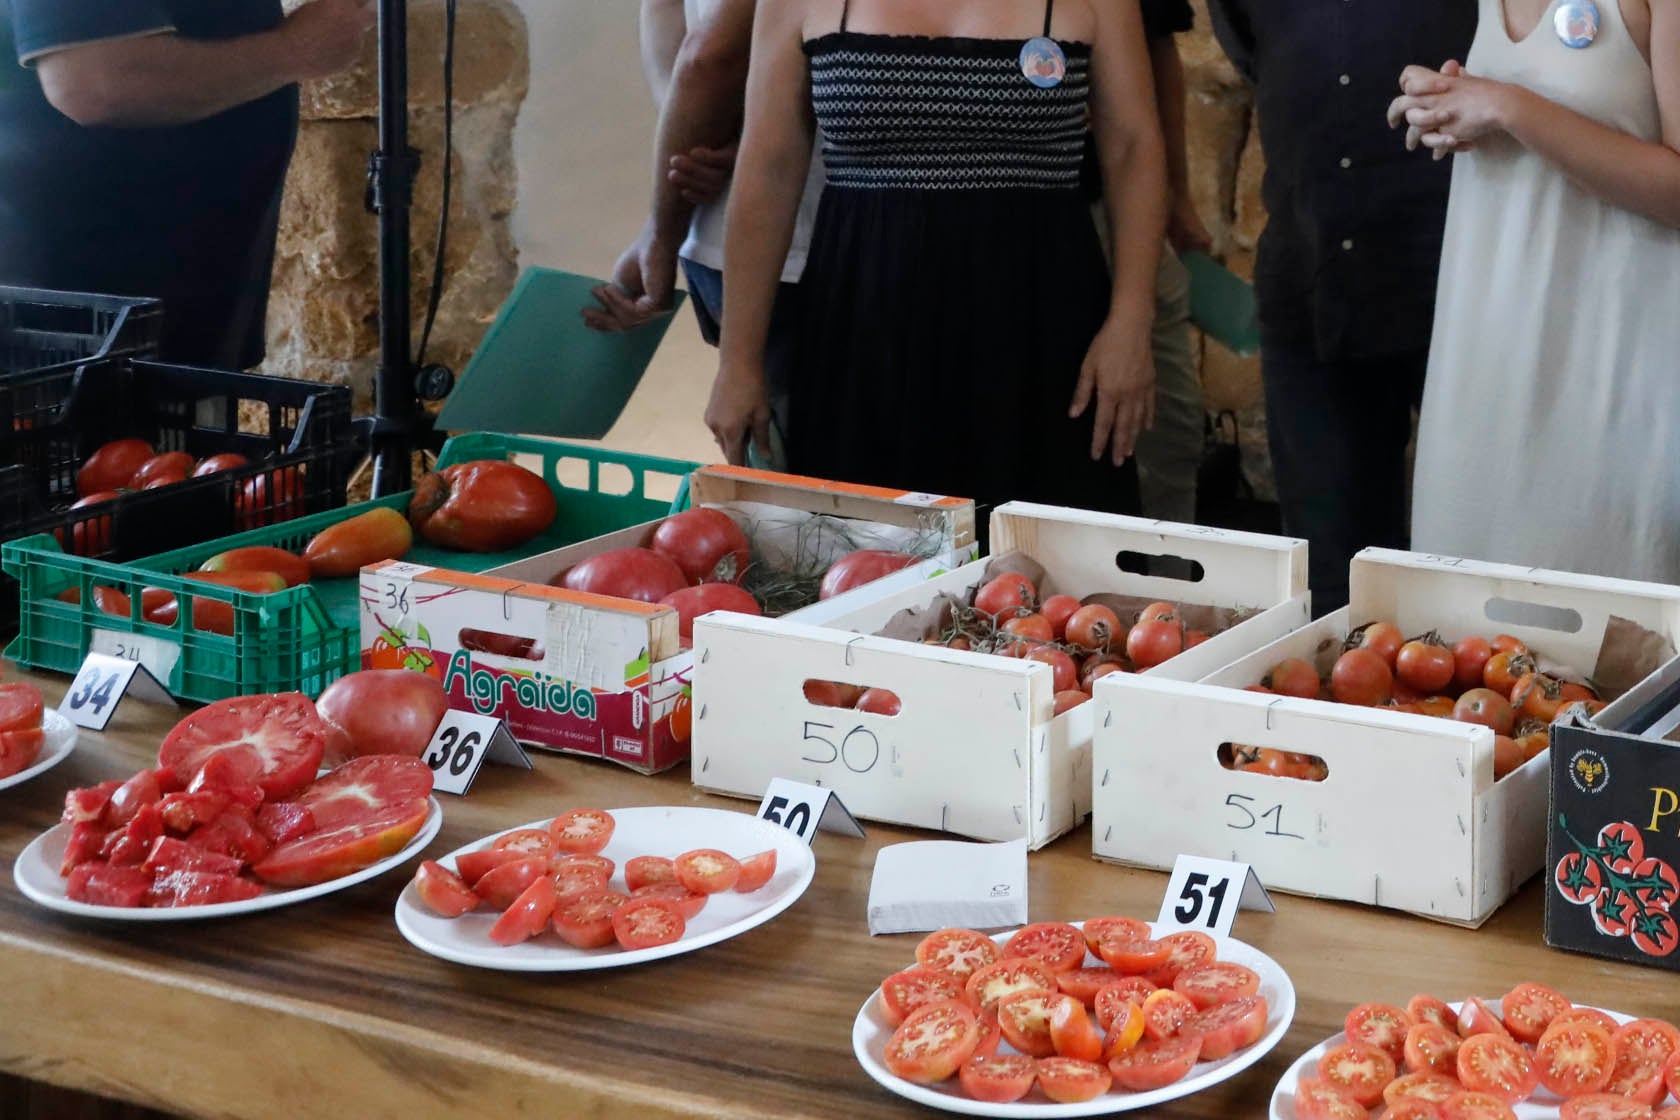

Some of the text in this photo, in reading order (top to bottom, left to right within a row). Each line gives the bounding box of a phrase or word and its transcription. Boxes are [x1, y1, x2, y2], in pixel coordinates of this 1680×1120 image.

[386, 583, 409, 615] 36
[70, 666, 120, 715] 34
[443, 648, 597, 721] Agraïda
[427, 726, 481, 776] 36
[802, 721, 879, 773] 50
[1226, 794, 1305, 840] 51
[1174, 872, 1230, 928] 51
